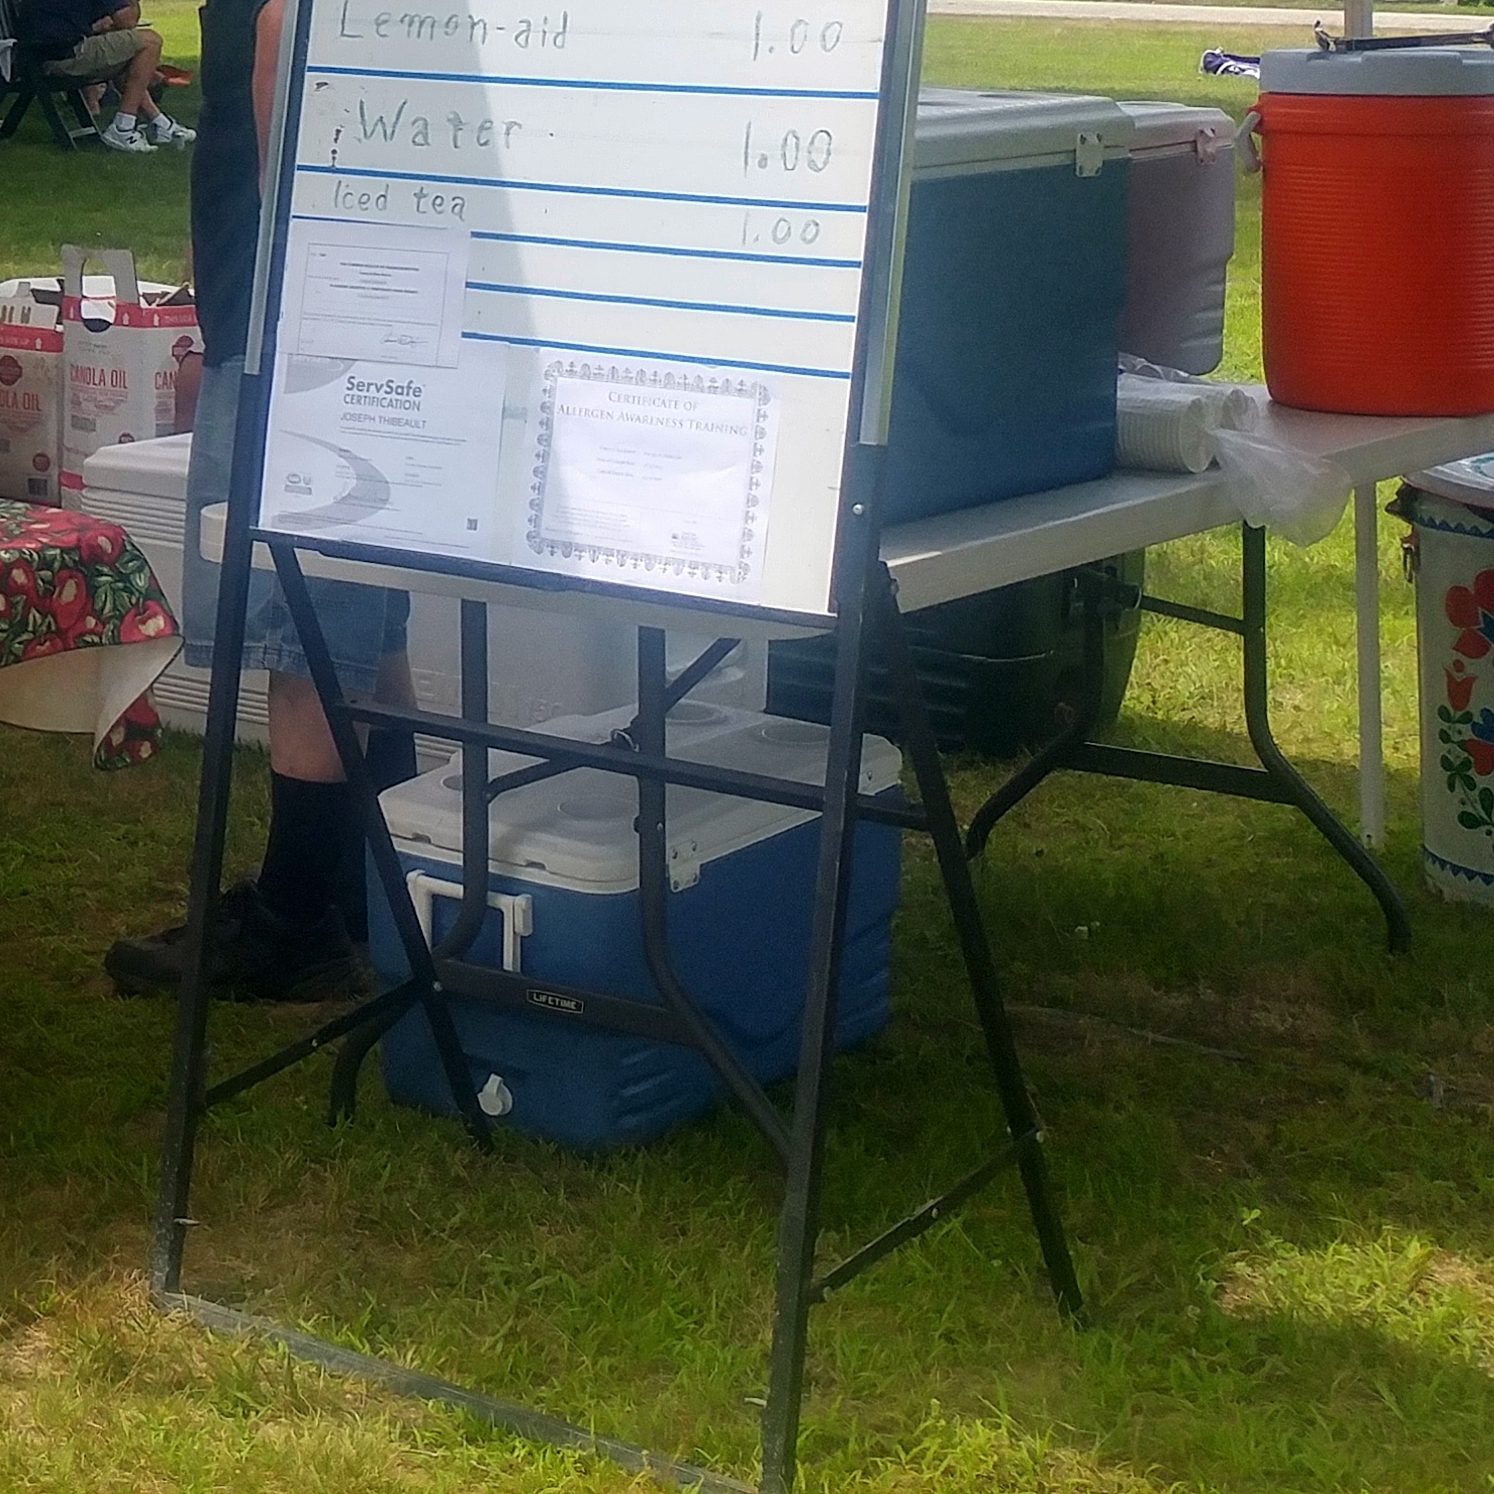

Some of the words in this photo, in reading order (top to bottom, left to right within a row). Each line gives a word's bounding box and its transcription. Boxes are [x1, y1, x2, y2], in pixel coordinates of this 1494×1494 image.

[752, 10, 842, 61] 1.00
[358, 98, 522, 149] Water
[742, 120, 833, 174] 1.00
[334, 180, 389, 212] Iced
[413, 186, 466, 222] tea
[741, 212, 820, 246] 1.00
[111, 369, 128, 389] OIL
[346, 376, 422, 398] ServSafe
[23, 393, 41, 411] OIL
[343, 394, 421, 411] CERTIFICATION
[340, 412, 376, 424] JOSEPH
[378, 415, 427, 429] THIBEAULT
[558, 404, 613, 420] ALLERGEN
[618, 411, 684, 428] AWARENESS
[688, 419, 748, 437] TRAINING
